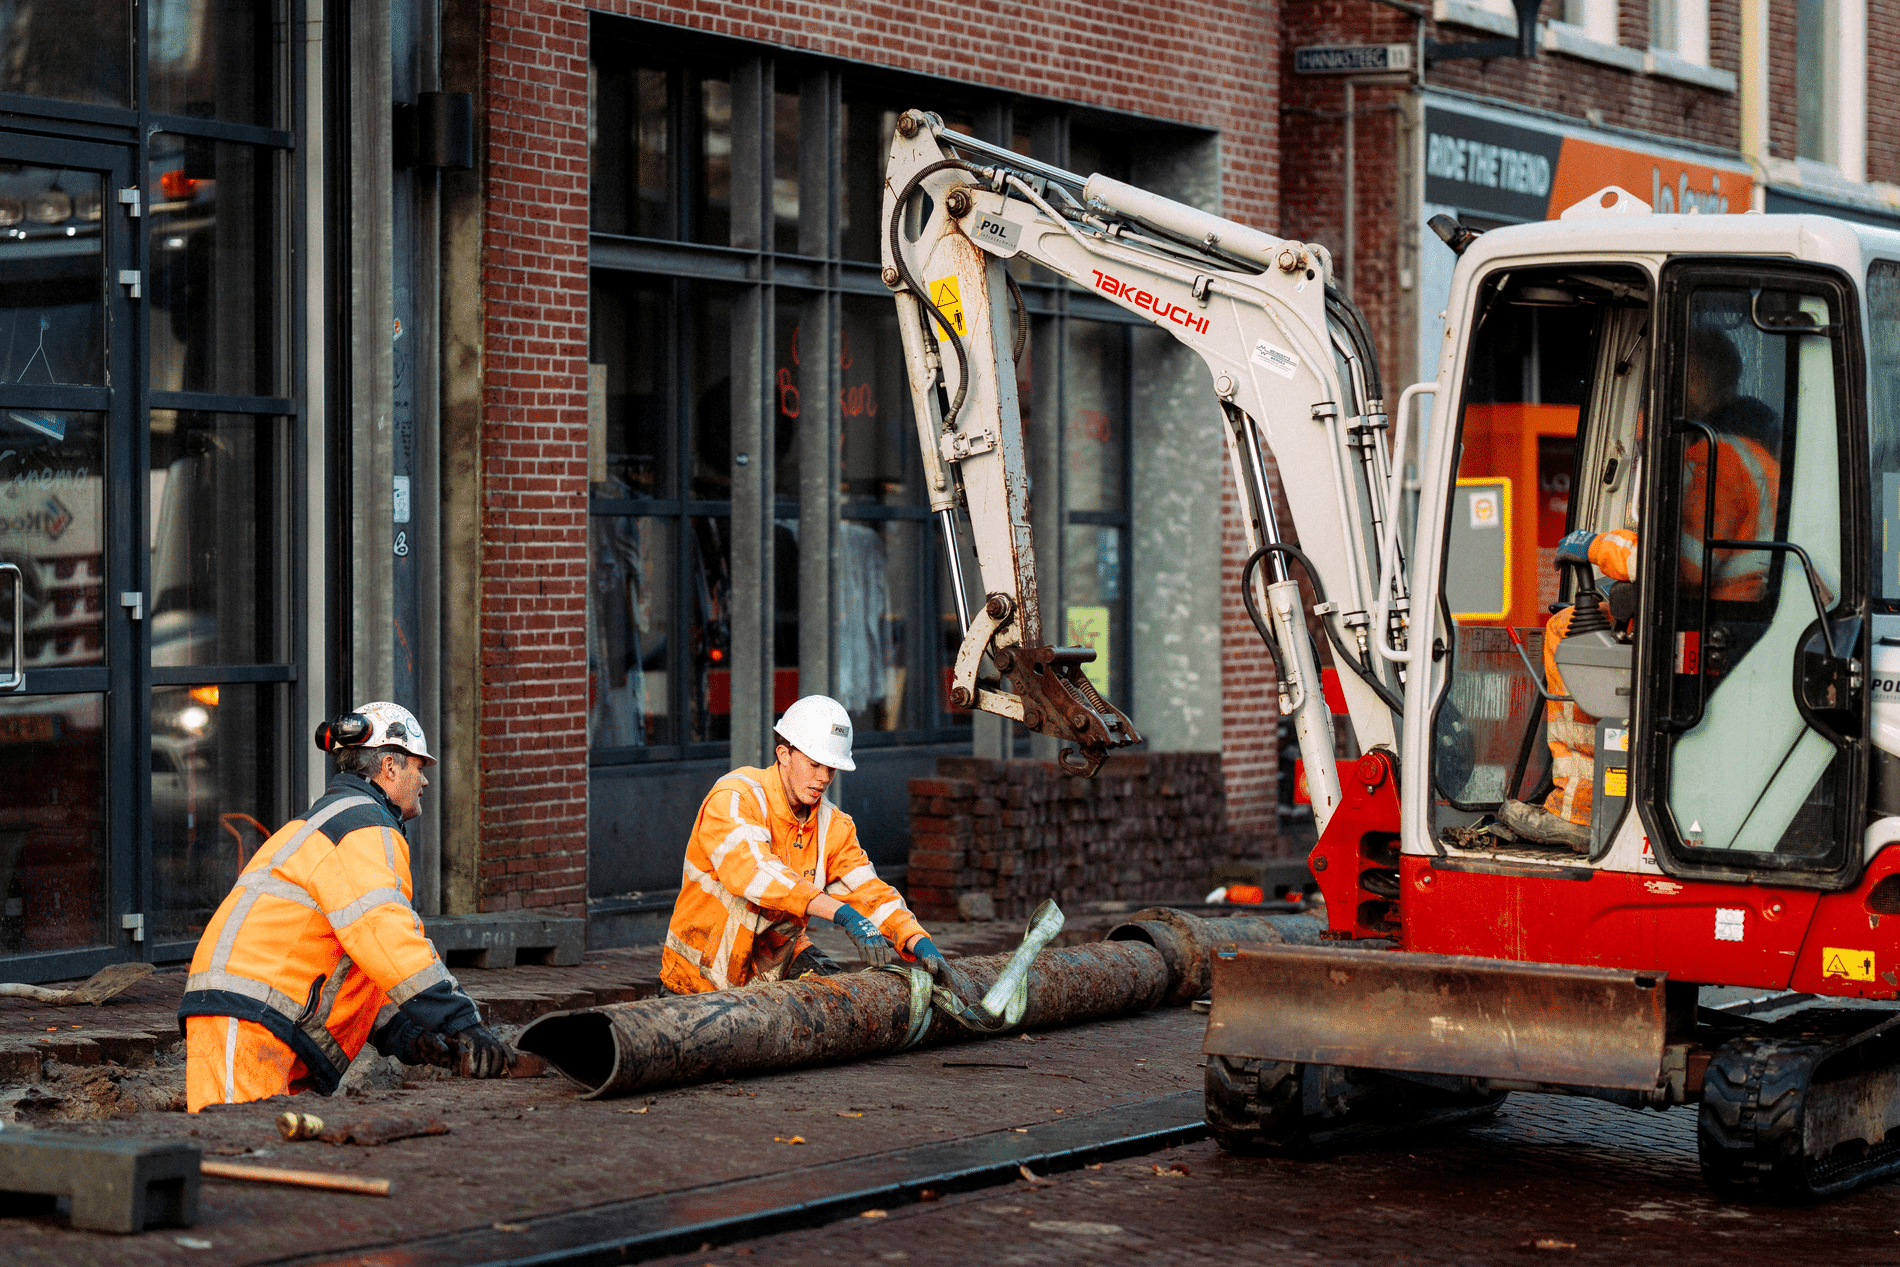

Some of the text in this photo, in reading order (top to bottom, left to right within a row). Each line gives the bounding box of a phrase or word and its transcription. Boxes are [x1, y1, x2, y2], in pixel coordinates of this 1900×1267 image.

[1427, 132, 1550, 197] RIDE THE TREND
[980, 219, 1007, 238] POL
[1092, 269, 1210, 335] TAKEUCHI
[834, 726, 845, 734] POL
[803, 868, 816, 877] PO
